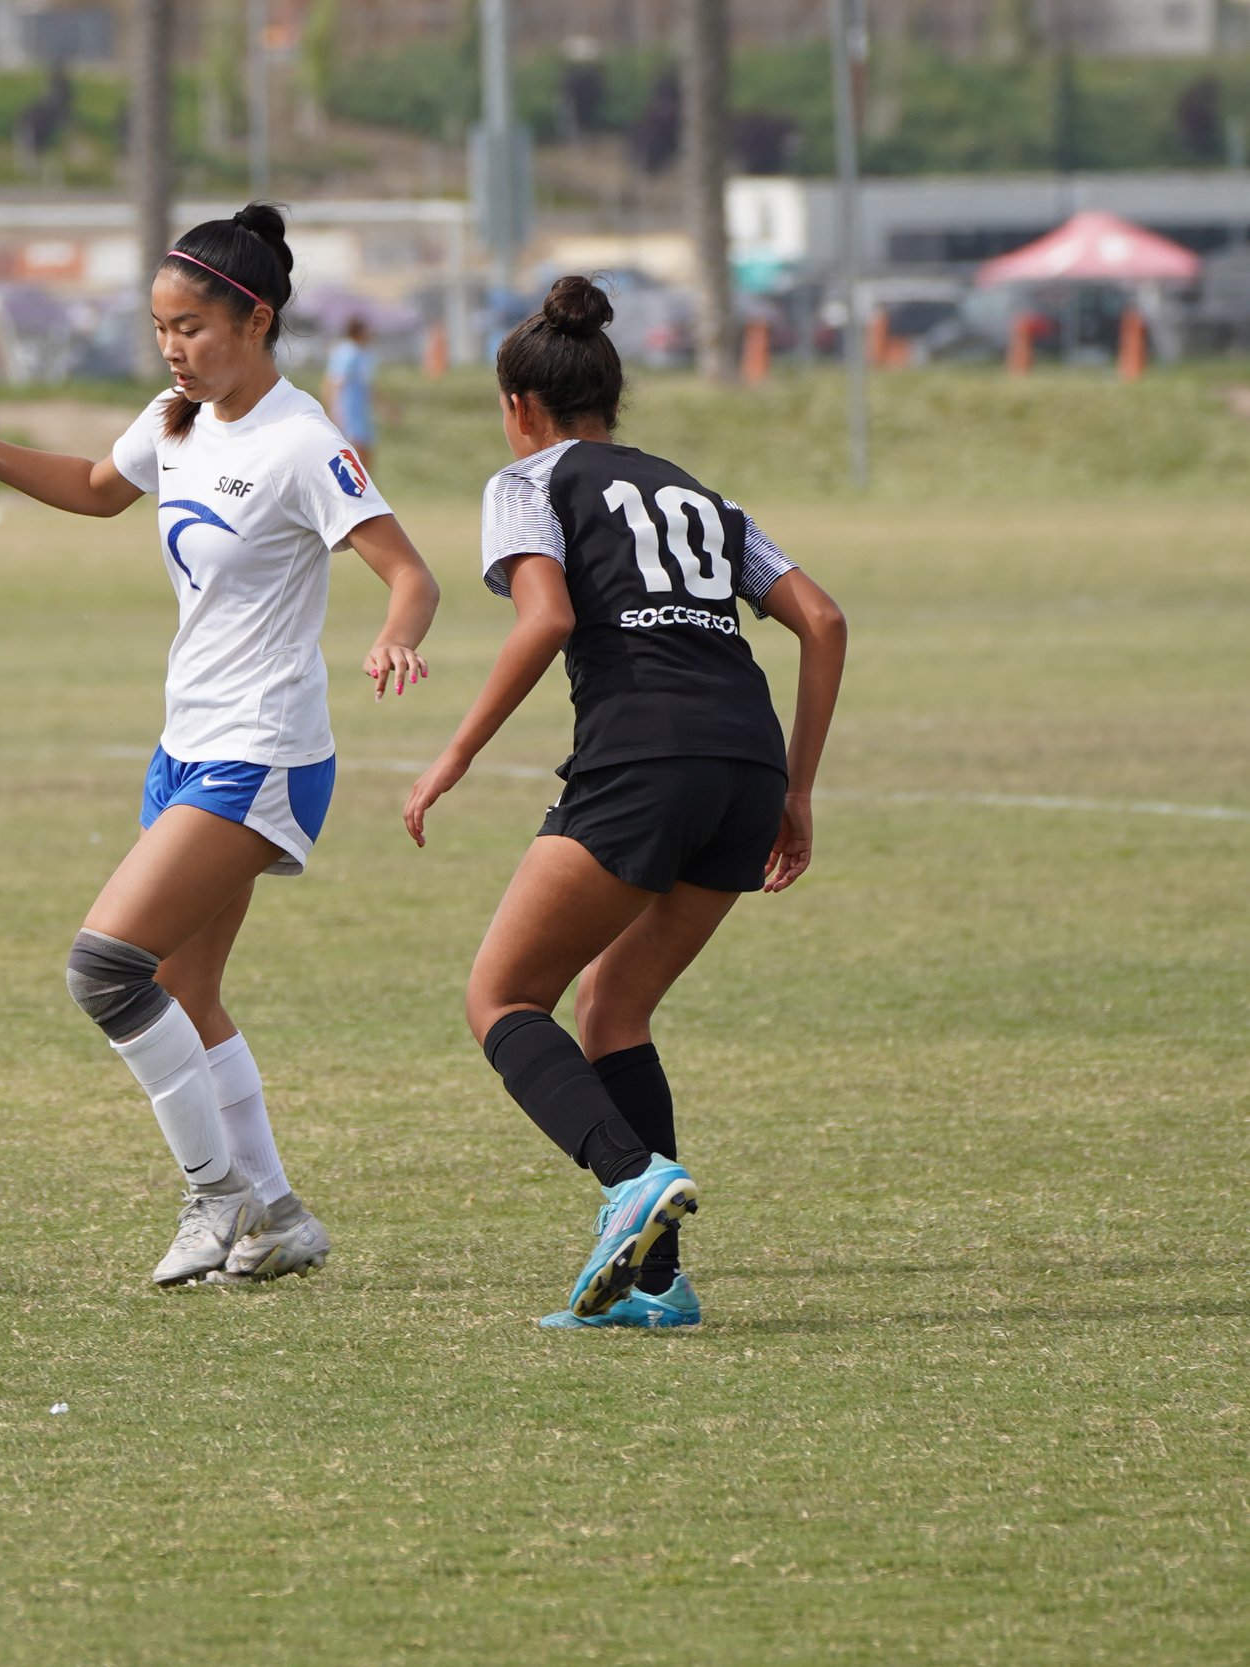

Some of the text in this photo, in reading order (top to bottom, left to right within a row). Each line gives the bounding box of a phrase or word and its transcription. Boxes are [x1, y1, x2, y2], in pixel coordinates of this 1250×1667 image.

[214, 475, 254, 498] SURF
[602, 480, 733, 600] 10
[620, 605, 739, 636] SOCCER.CO
